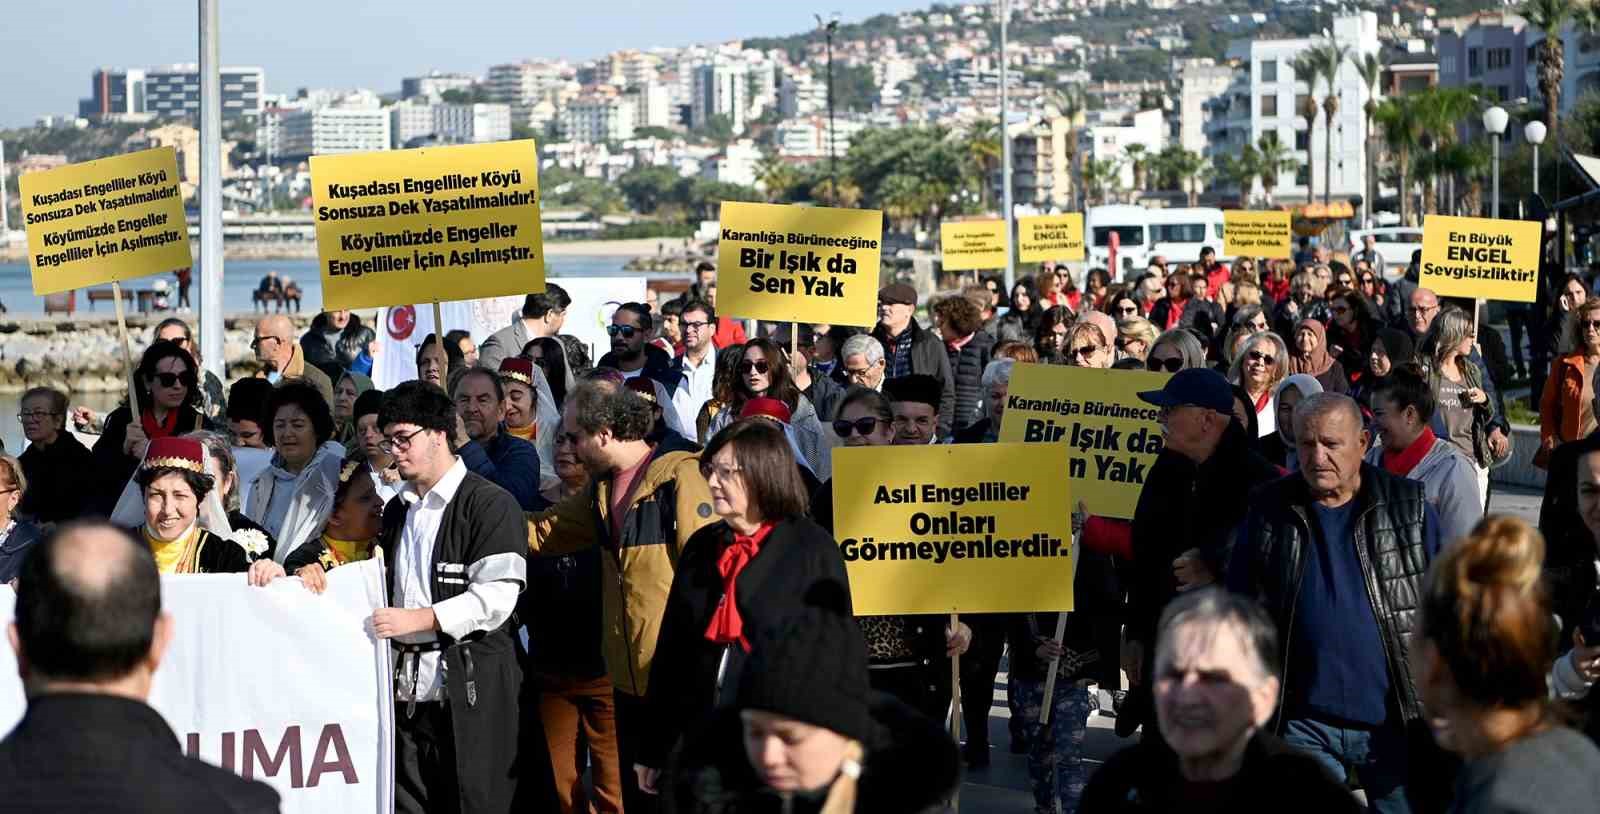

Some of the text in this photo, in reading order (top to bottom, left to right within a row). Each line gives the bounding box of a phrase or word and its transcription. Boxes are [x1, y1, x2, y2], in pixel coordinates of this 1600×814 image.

[32, 169, 167, 207] Kuşadası Engelliler Köyü
[328, 169, 521, 200] Kuşadası Engelliler Köyü
[27, 185, 179, 224] Sonsuza Dek Yaşatılmalıdır!
[318, 190, 535, 222] Sonsuza Dek Yaşatılmalıdır!
[43, 212, 168, 247] Köyümüzde Engeller
[340, 222, 518, 252] Köyümüzde Engeller
[722, 228, 878, 250] Karanlığa Bürüneceğine
[1033, 231, 1069, 241] ENGEL
[1449, 231, 1513, 247] En Büyük
[35, 230, 182, 267] Engelliler İçin Aşılmıştır.
[328, 244, 535, 277] Engelliler İçin Aşılmıştır.
[739, 247, 857, 275] Bir Işık da
[1447, 246, 1512, 264] ENGEL
[749, 271, 845, 297] Sen Yak
[1423, 262, 1535, 283] Sevgisizliktir!
[1007, 395, 1081, 416] Karanlığa
[1024, 418, 1165, 455] Bir Işık da
[1094, 454, 1146, 485] Yak
[873, 481, 1031, 506] Asıl Engelliler
[909, 511, 996, 536] Onları
[839, 533, 1069, 564] Görmeyenlerdir.
